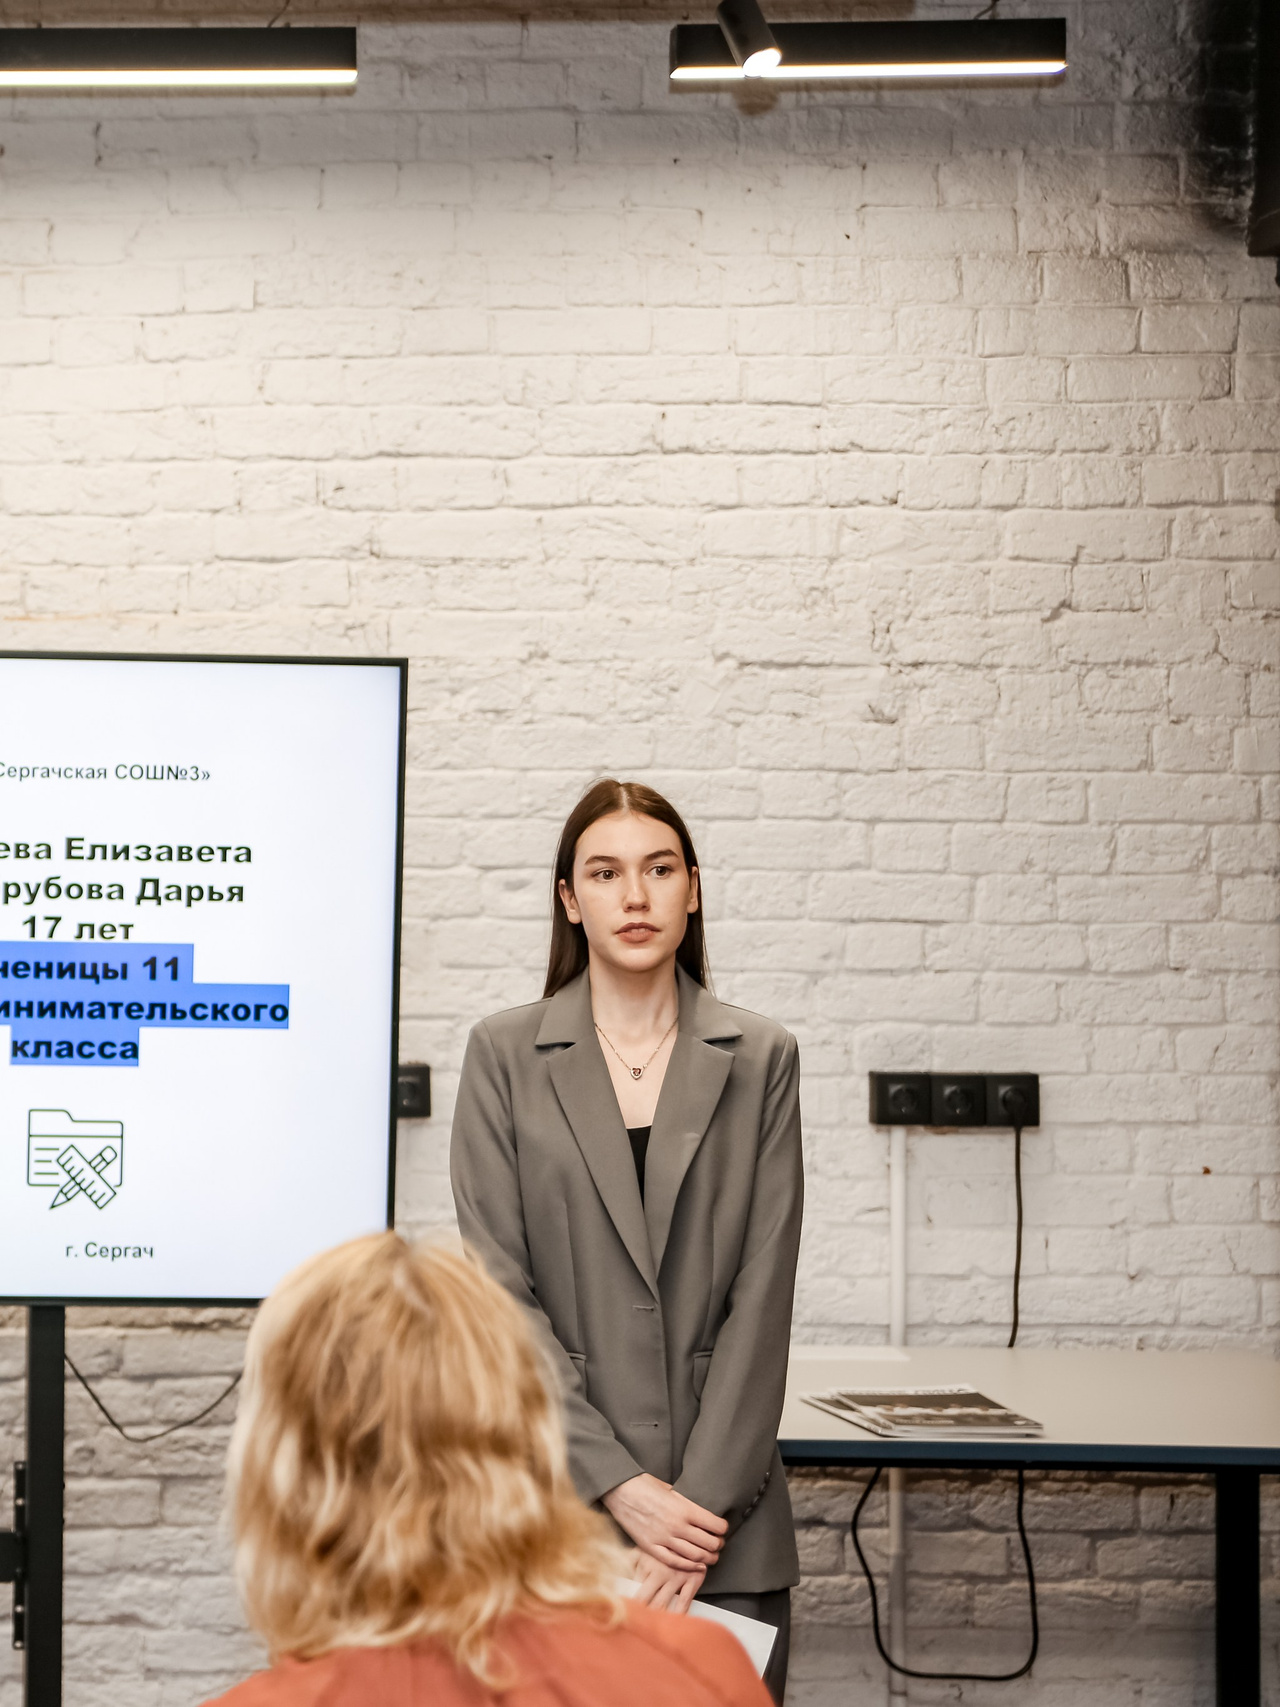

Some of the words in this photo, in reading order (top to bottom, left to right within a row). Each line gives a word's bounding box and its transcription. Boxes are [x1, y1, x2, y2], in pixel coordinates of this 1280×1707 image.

[114, 763, 212, 782] СОШ№3»
[64, 836, 253, 864] Елизавета
[135, 877, 245, 908] Дарья
[22, 915, 62, 940] 17
[73, 922, 135, 941] лет
[142, 956, 180, 981] 11
[11, 1037, 139, 1060] класса
[65, 1245, 79, 1258] г.
[84, 1241, 154, 1262] Сергач
